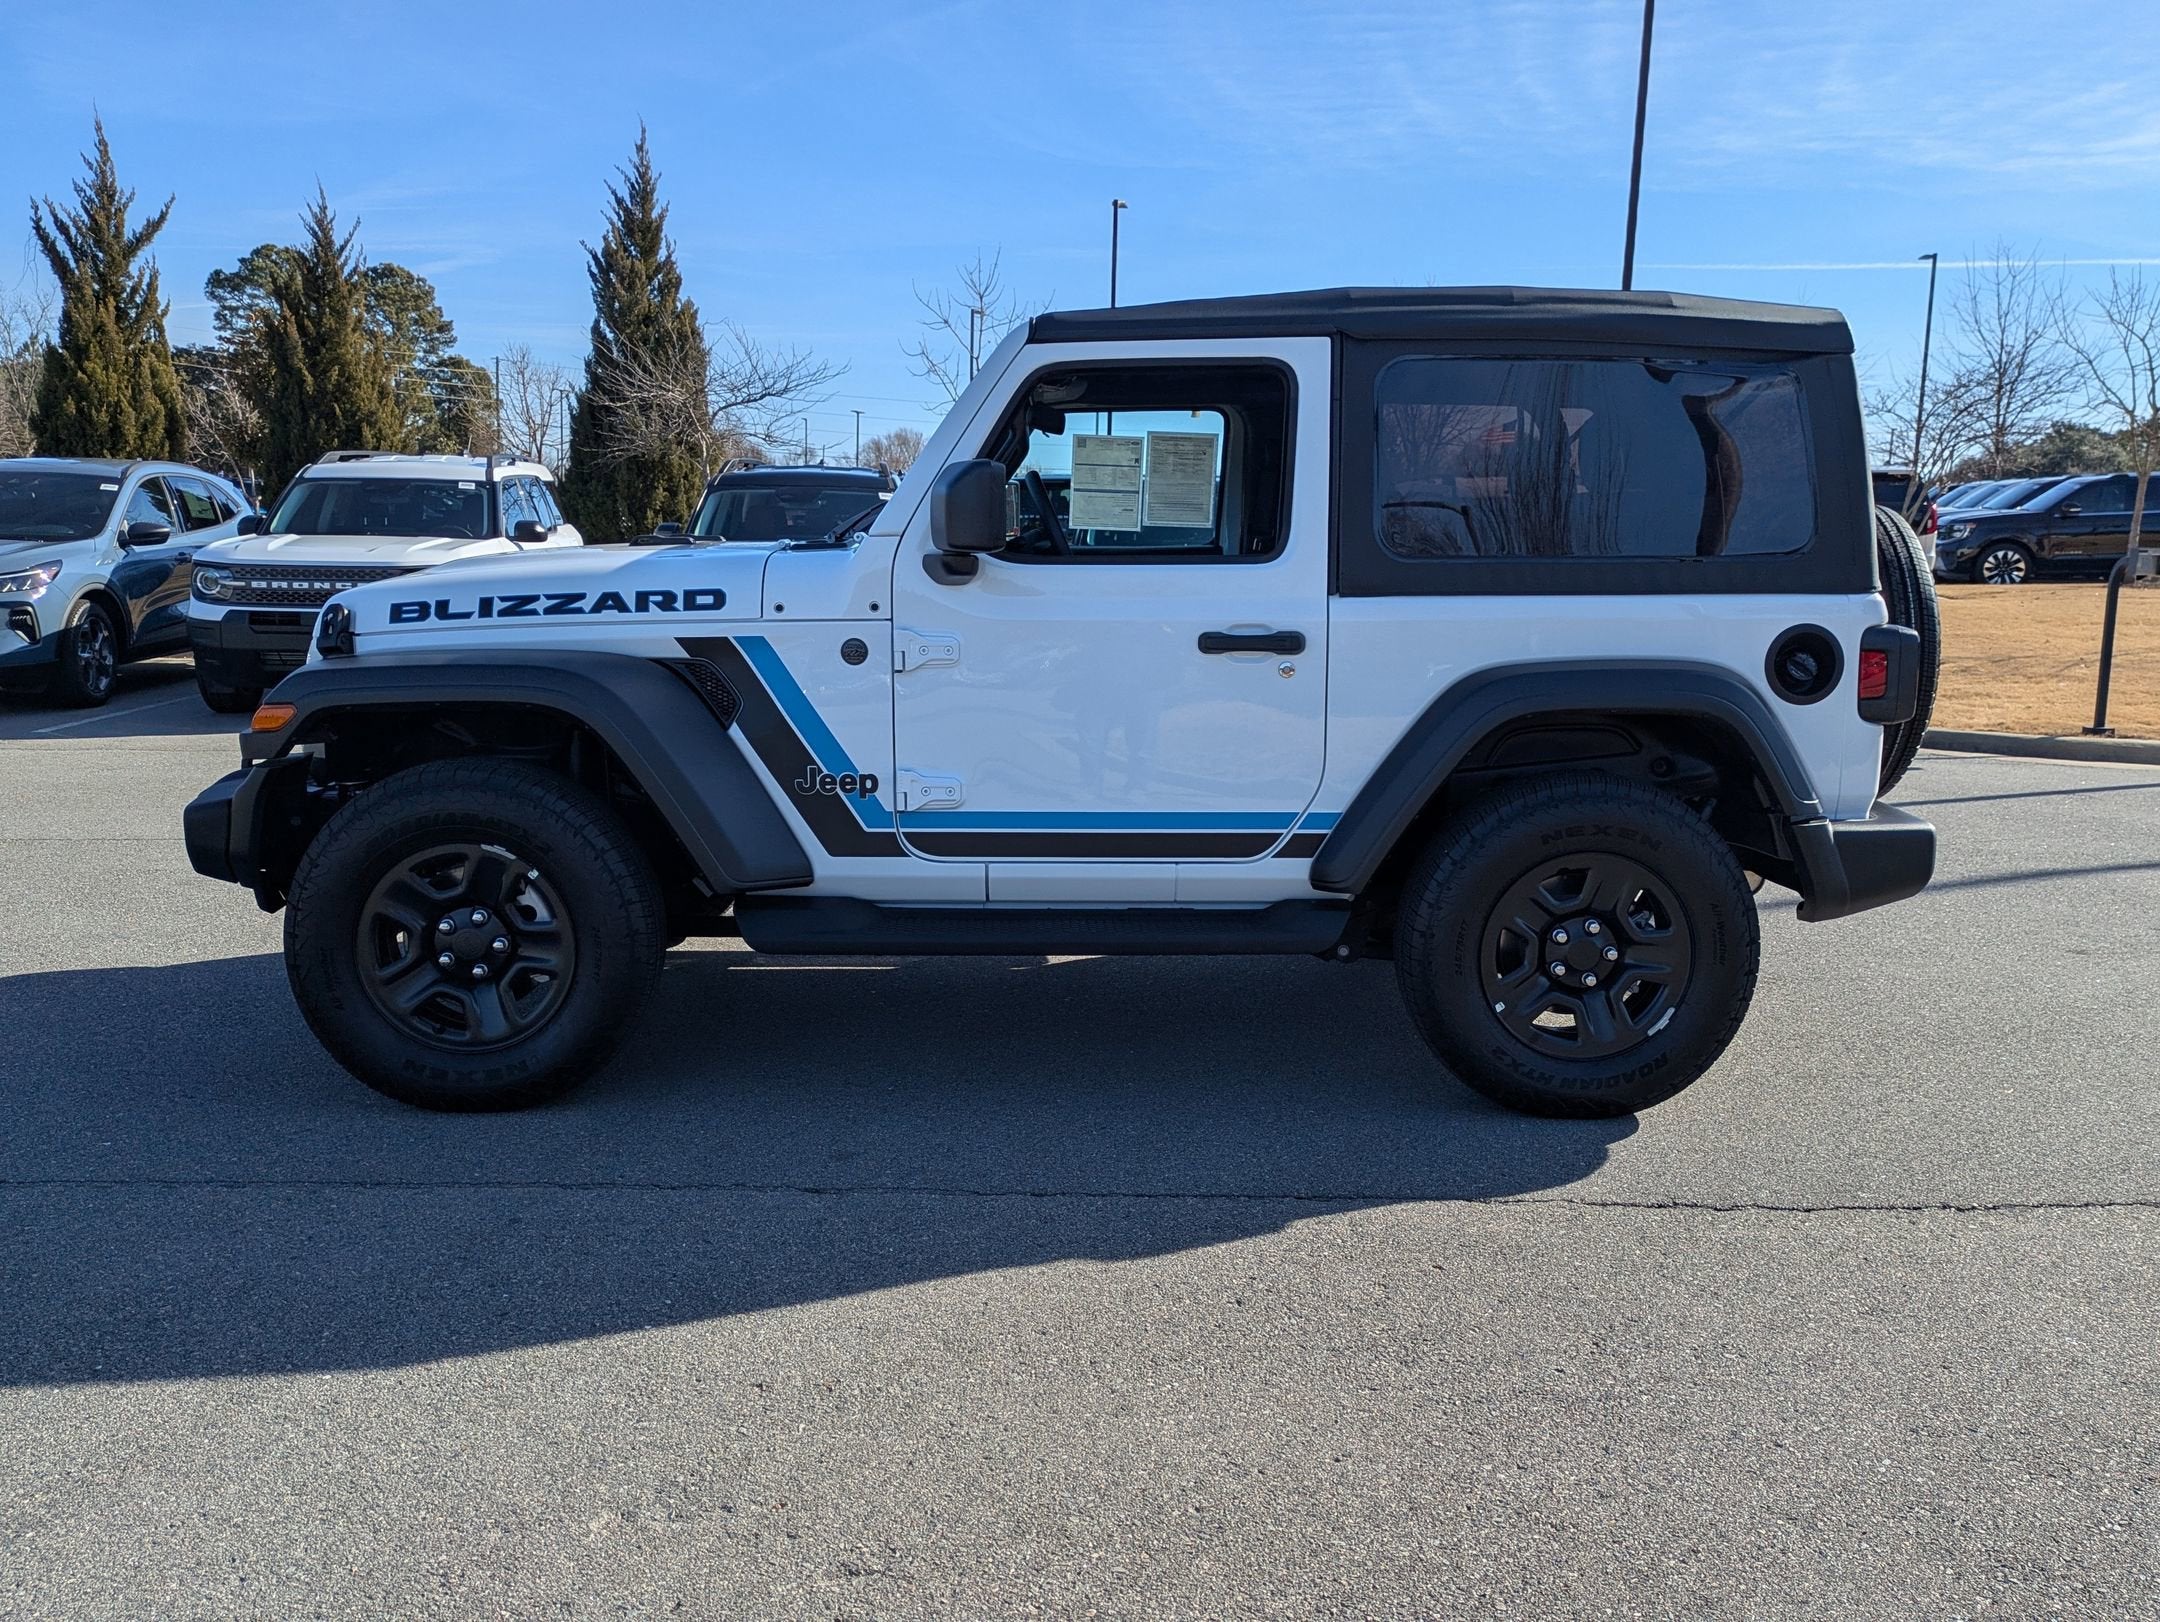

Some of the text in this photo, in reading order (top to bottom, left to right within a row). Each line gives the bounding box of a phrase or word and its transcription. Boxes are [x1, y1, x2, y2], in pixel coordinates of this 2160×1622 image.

[389, 588, 727, 624] BLIZZARD
[794, 765, 879, 800] Jeep
[1541, 825, 1662, 851] NEXEN
[1559, 1052, 1669, 1089] ROADIAN
